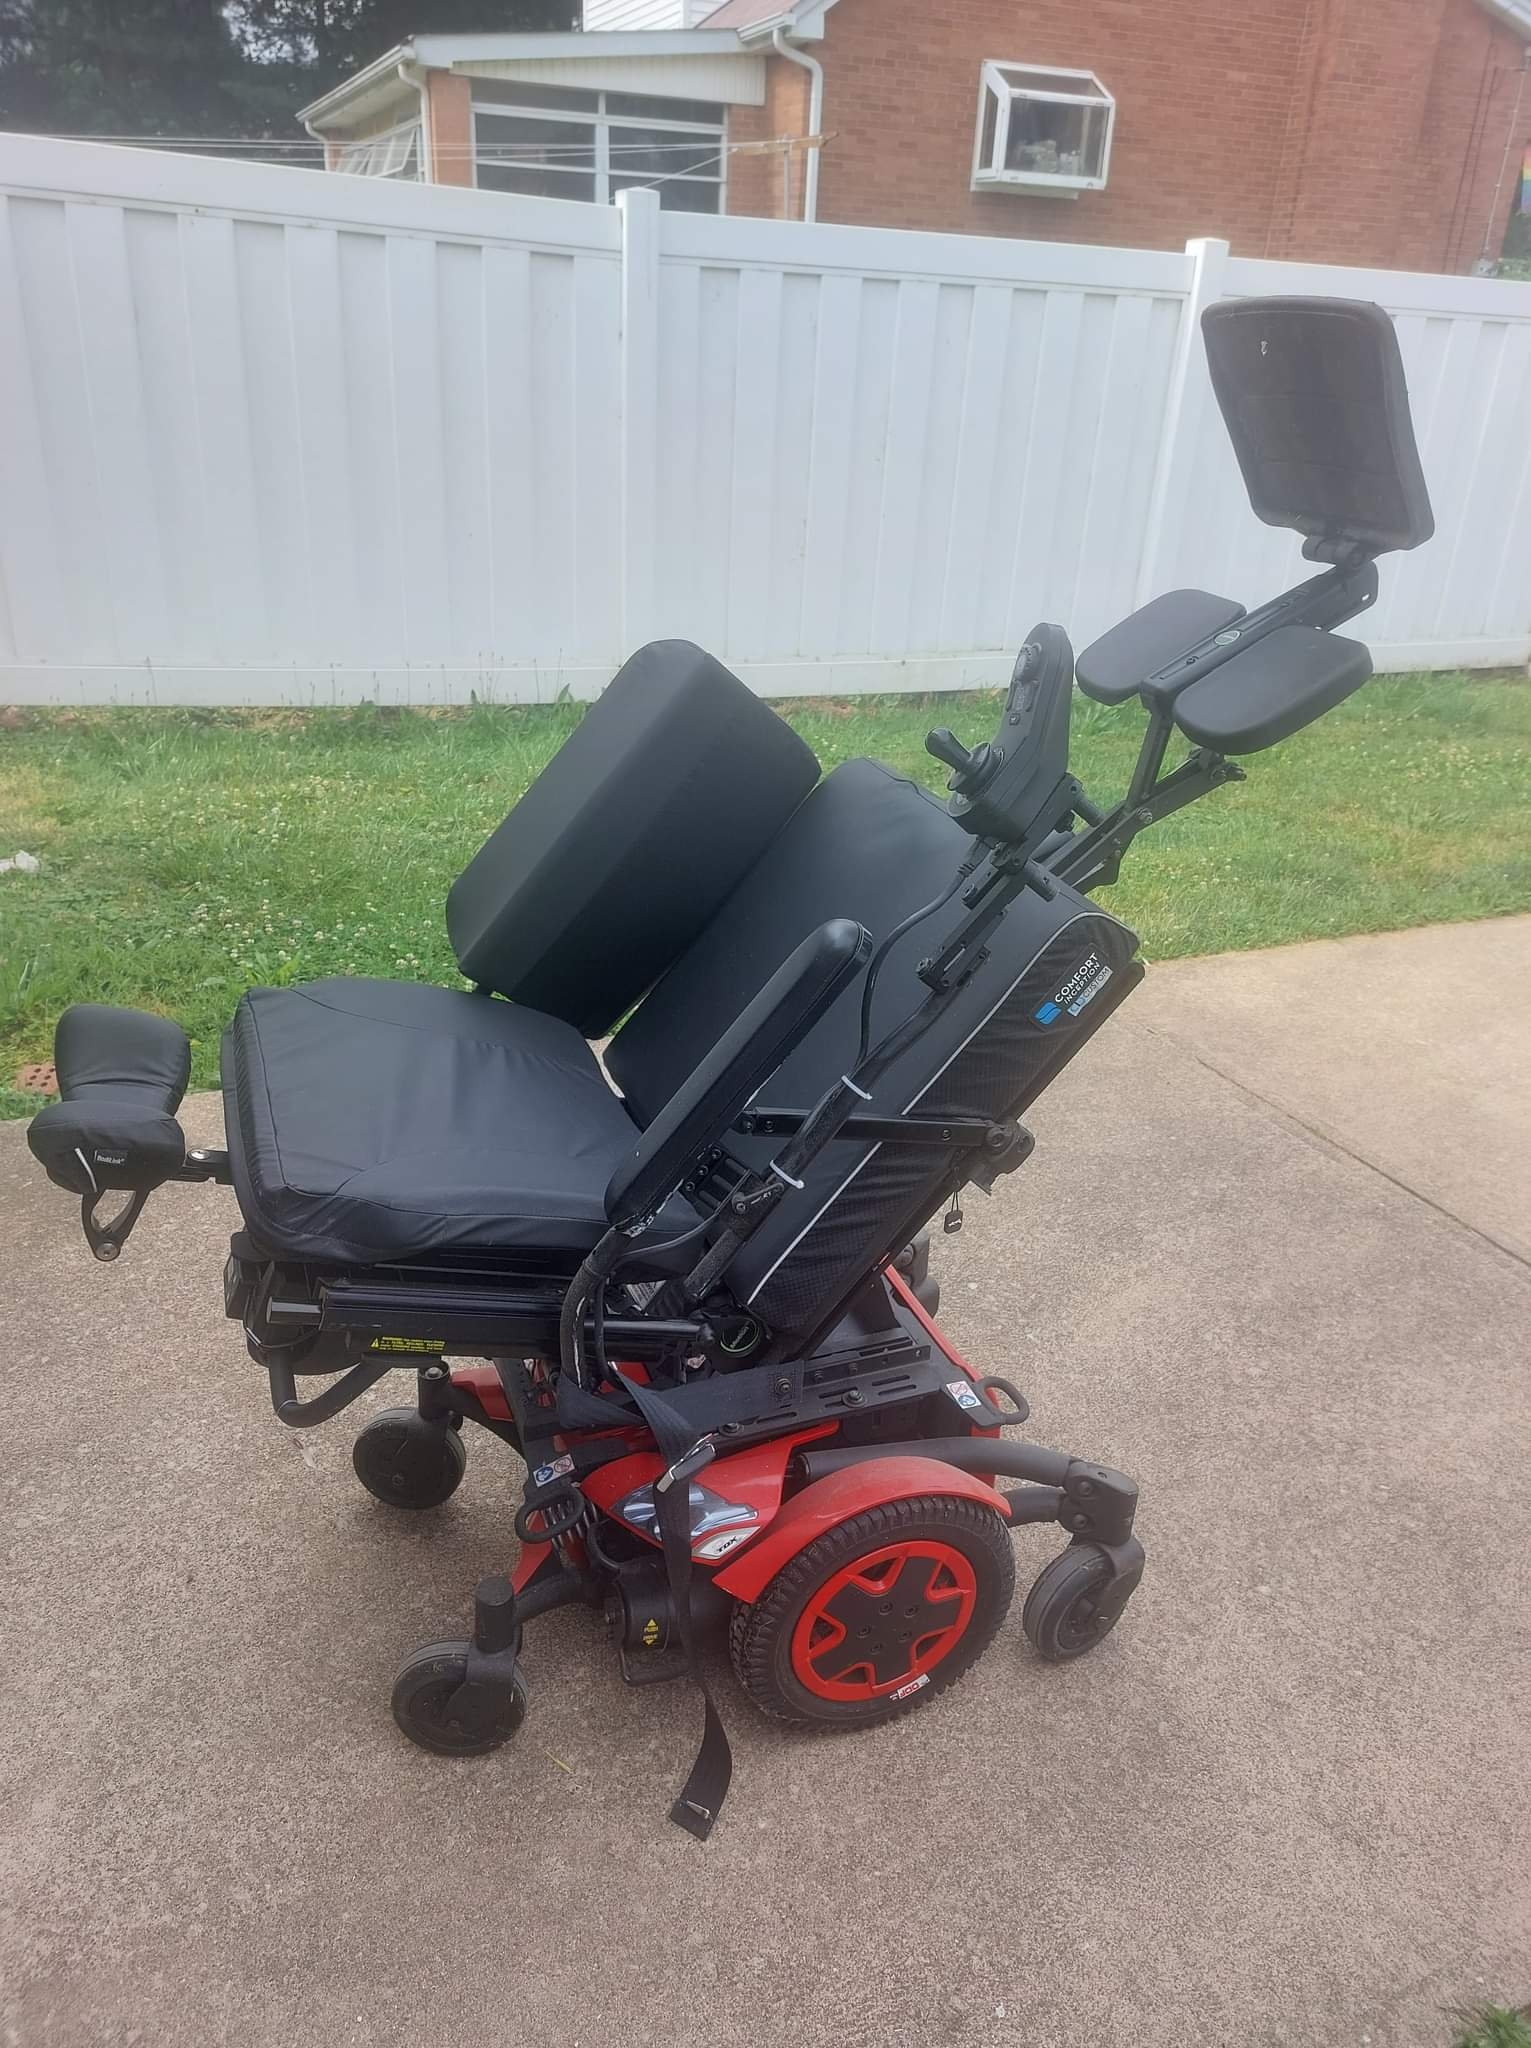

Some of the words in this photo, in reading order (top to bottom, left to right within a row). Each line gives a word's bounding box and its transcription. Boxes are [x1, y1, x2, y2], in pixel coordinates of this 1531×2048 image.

[1055, 952, 1098, 1003] COMFORT
[1063, 962, 1101, 1005] INCEPTION
[1083, 967, 1110, 998] CUSTOM
